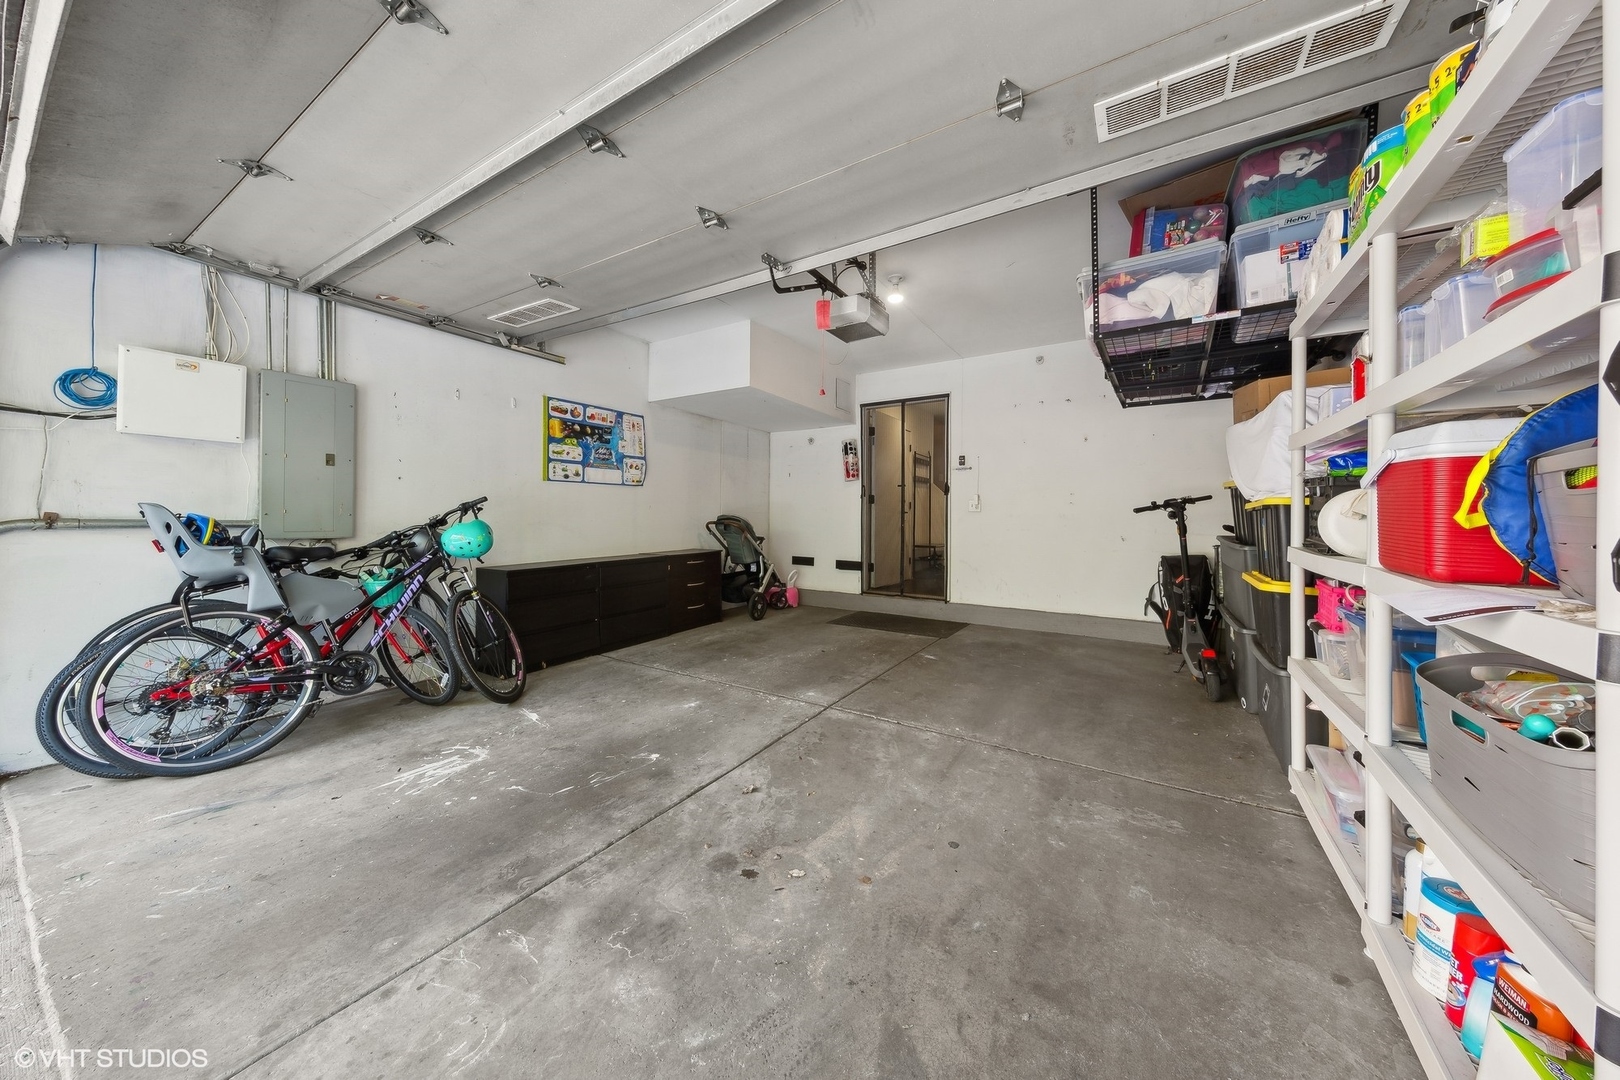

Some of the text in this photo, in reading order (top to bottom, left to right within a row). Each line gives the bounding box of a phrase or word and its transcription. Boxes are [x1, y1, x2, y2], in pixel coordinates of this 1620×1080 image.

[1286, 215, 1309, 224] Hefty
[1493, 987, 1530, 1027] HARDWOOD
[1498, 977, 1527, 1009] WEIMAN
